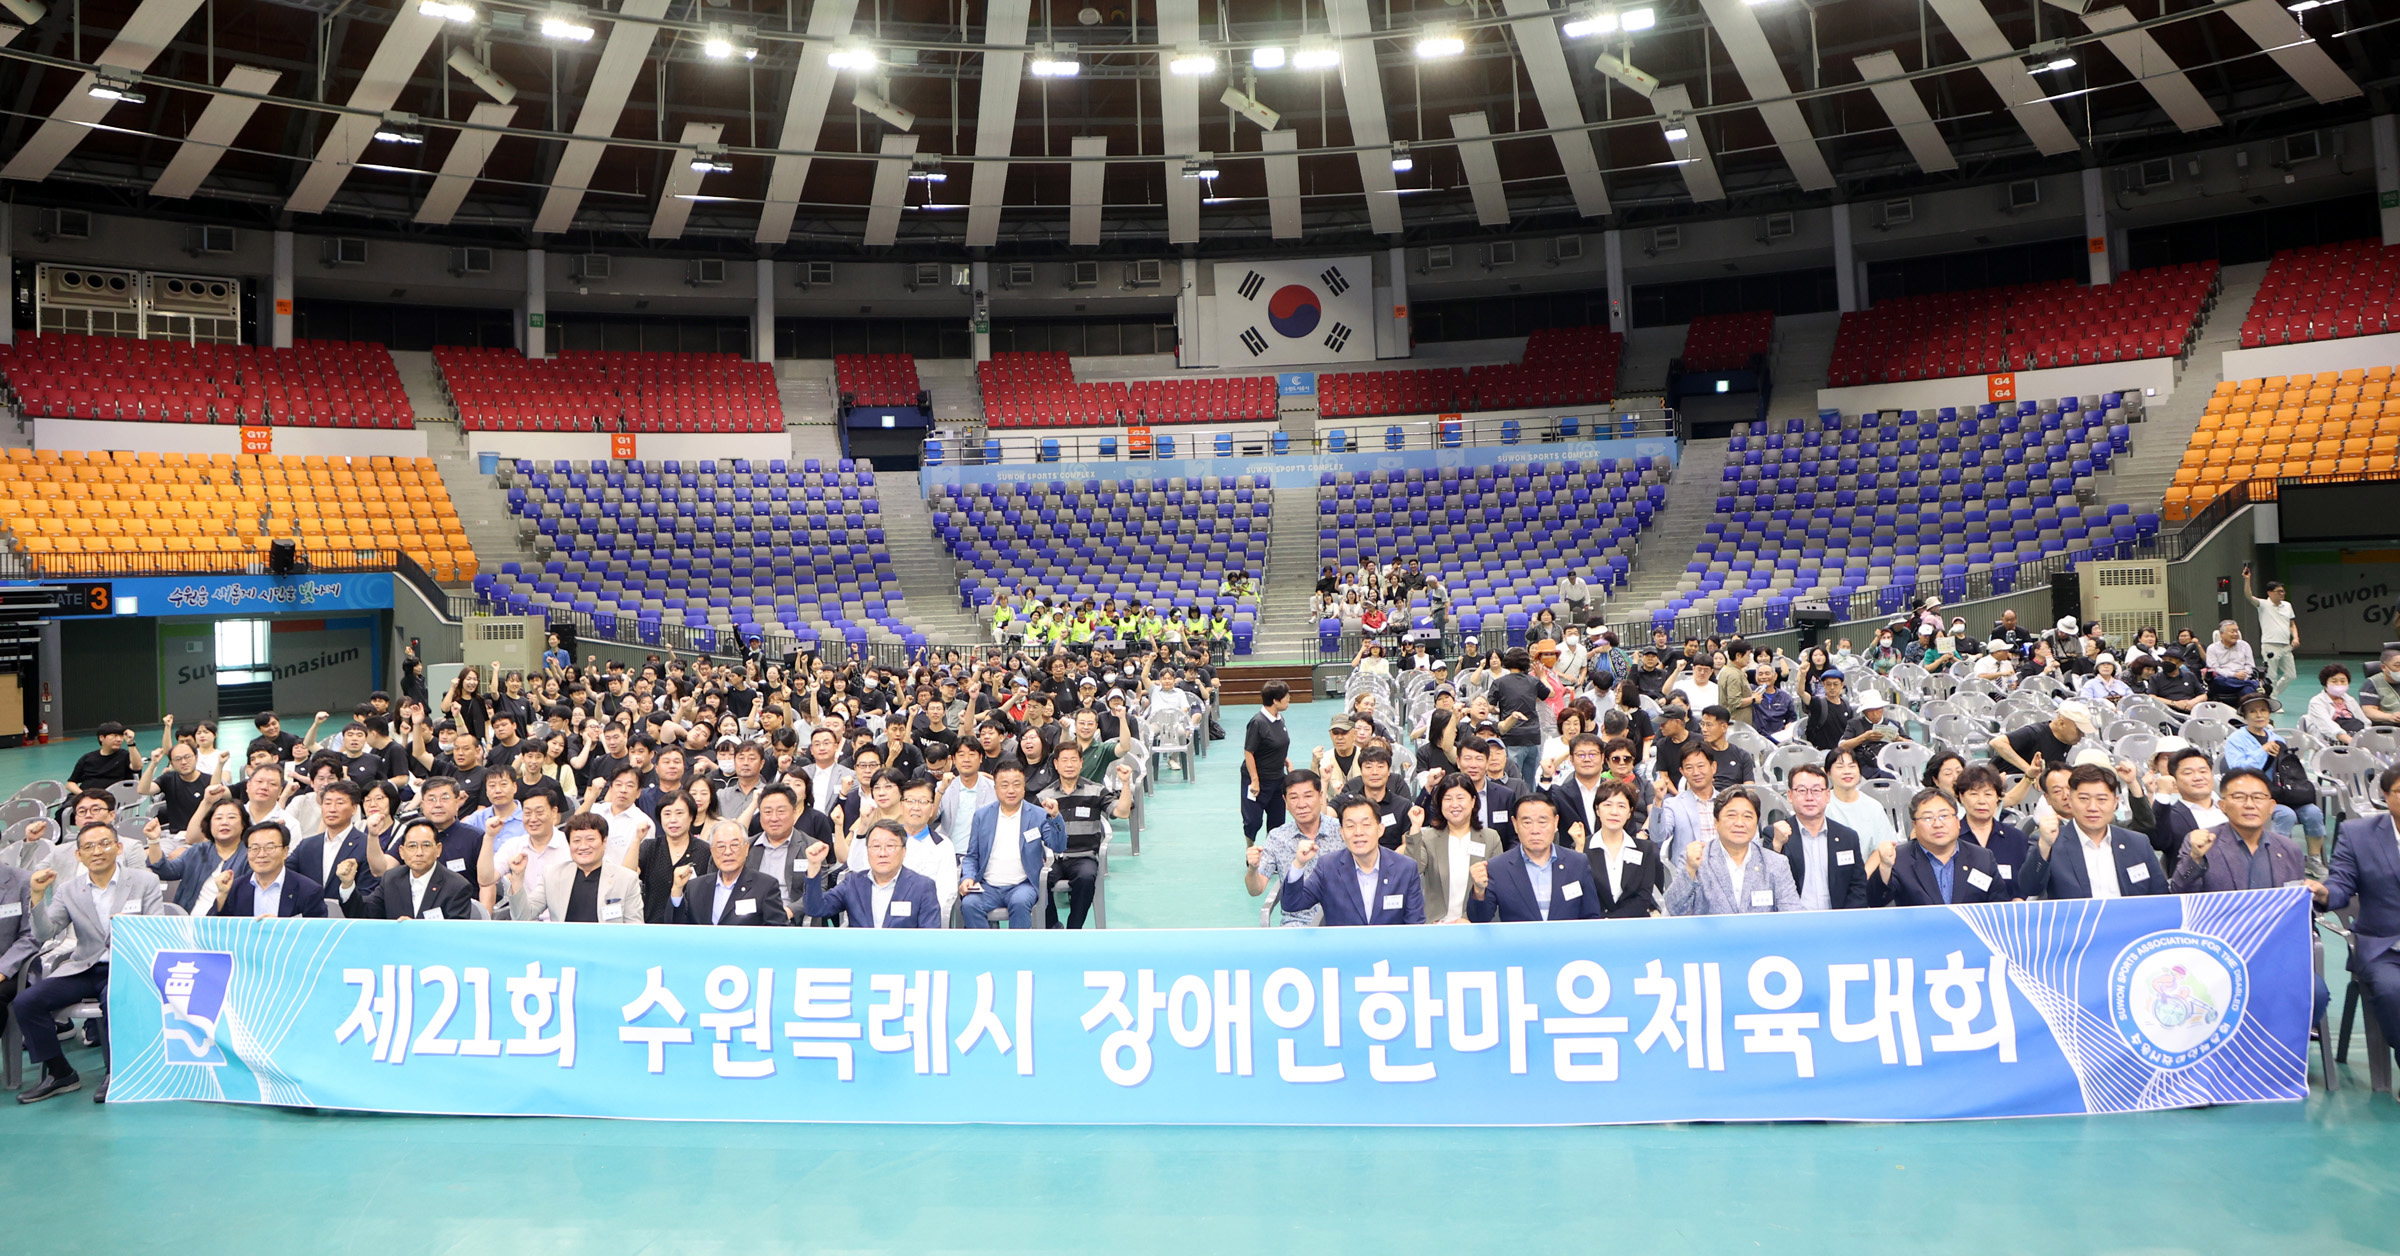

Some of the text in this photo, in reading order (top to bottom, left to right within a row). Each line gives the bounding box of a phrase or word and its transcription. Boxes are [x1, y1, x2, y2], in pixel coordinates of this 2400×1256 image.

[1994, 377, 2010, 386] G4
[1994, 389, 2011, 398] G4
[246, 430, 268, 439] G17
[617, 436, 631, 444] G1
[247, 442, 268, 450] G17
[617, 447, 631, 455] G1
[1246, 463, 1344, 474] SUWON SPORTS COMPLEX
[1027, 472, 1057, 480] SPORTS
[1060, 471, 1096, 479] COMPLEX
[90, 586, 108, 610] 3
[168, 581, 341, 608] 수원을 새롭게 시민을 빛나게
[2306, 583, 2388, 612] Suwon
[2116, 936, 2243, 1021] SUWON SPORTS ASSOCIATION FOR THE DISABLED
[334, 960, 578, 1068] 제21회
[617, 964, 1036, 1082] 수원특례시
